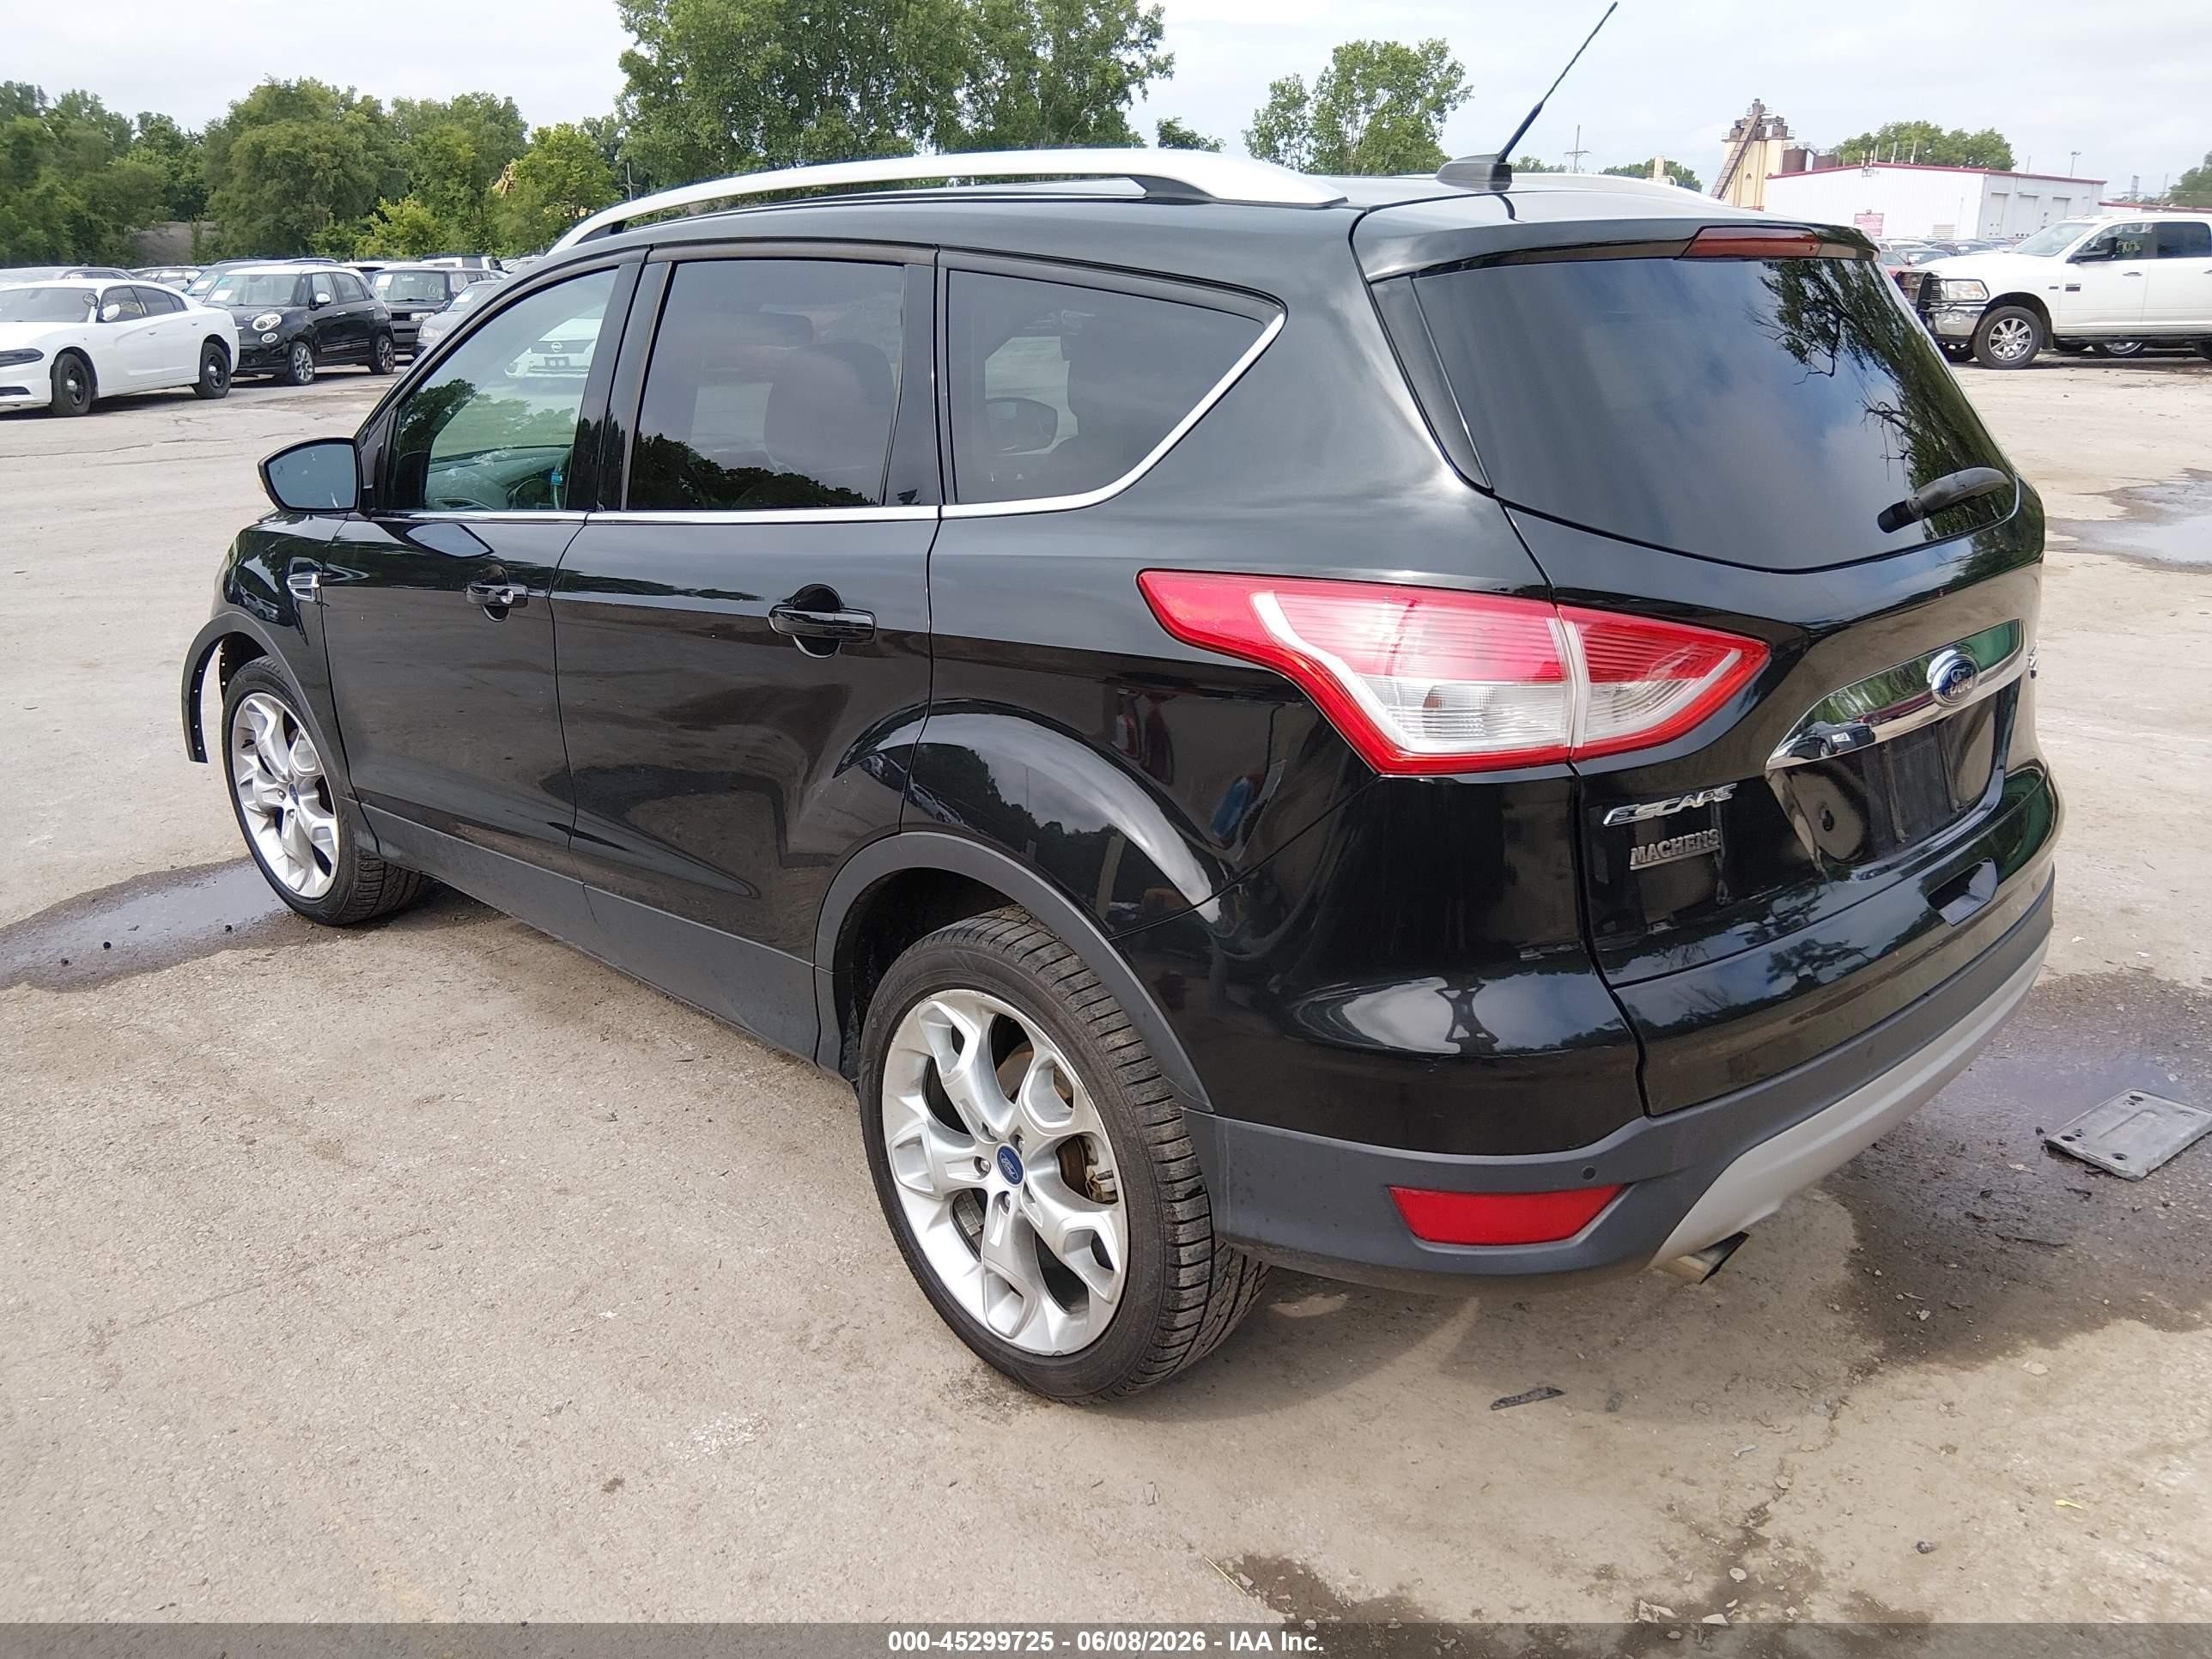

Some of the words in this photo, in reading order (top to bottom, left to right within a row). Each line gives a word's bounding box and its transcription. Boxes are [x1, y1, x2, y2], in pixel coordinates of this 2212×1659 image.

[1948, 665, 1975, 697] Ford
[1602, 782, 1738, 827] ESCAPE
[1630, 828, 1720, 867] MACHENS
